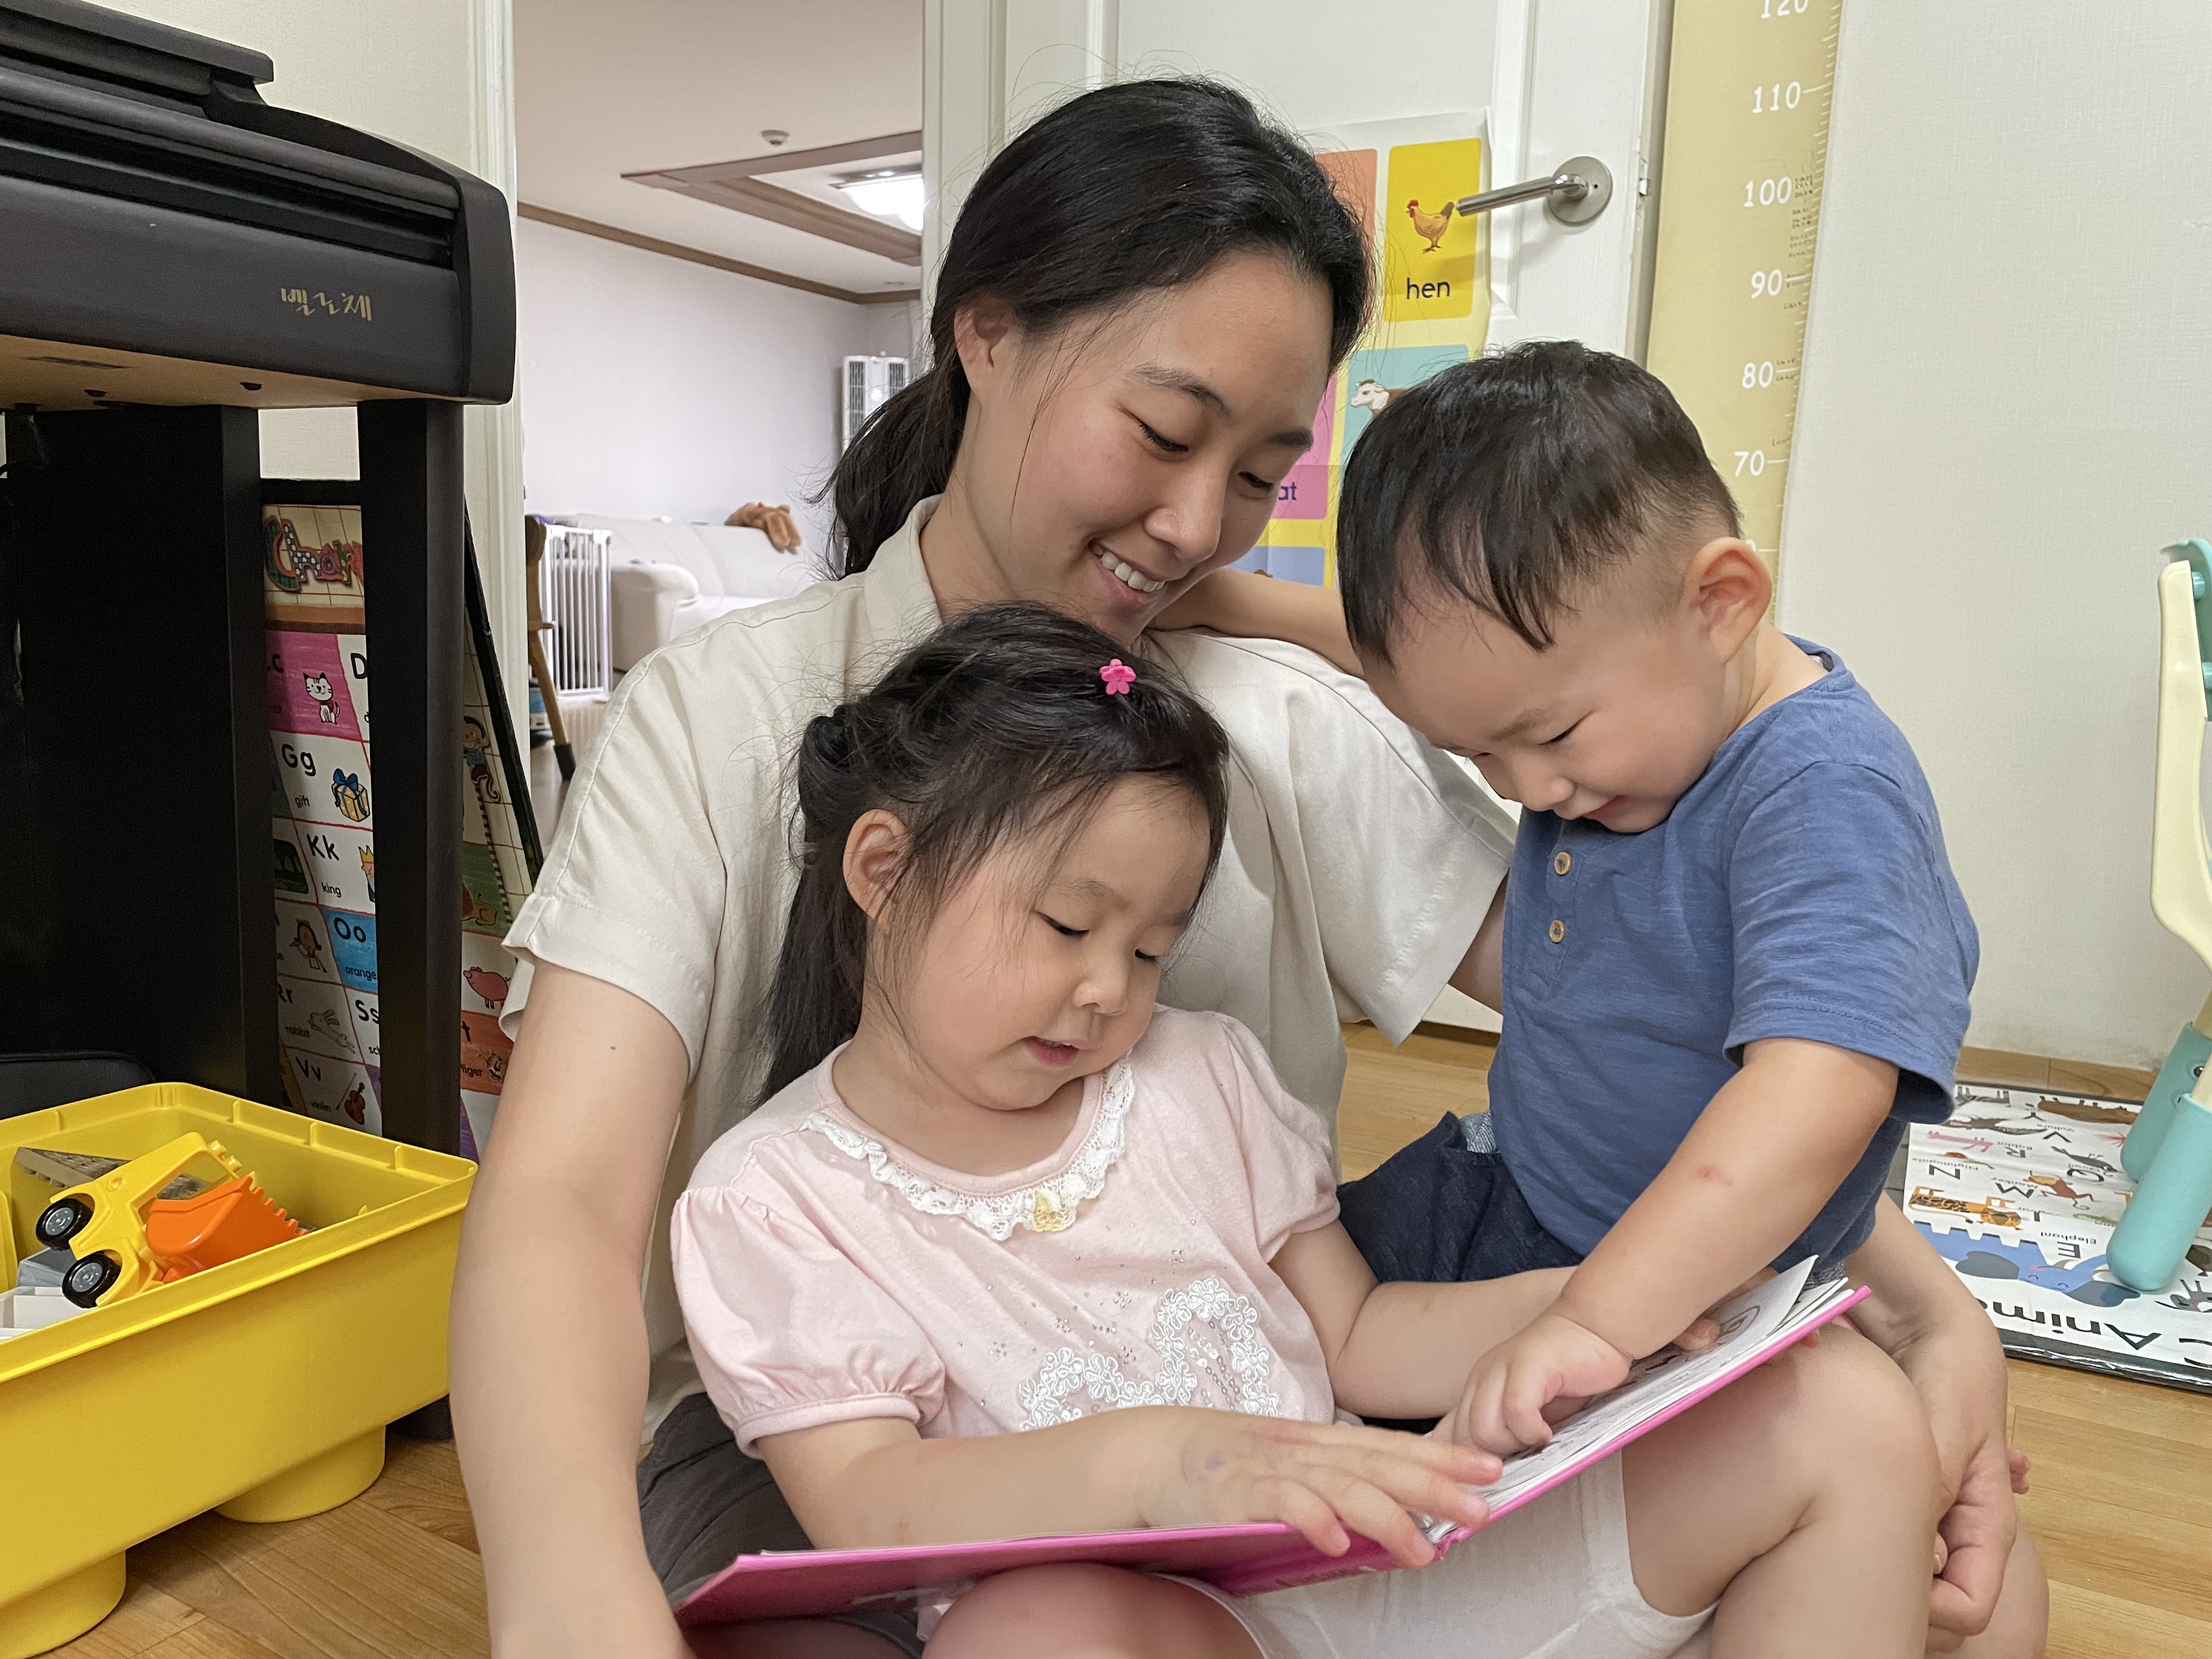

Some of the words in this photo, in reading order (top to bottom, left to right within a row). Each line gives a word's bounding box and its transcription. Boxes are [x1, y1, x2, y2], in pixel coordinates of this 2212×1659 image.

[1752, 81, 1801, 113] 110
[1744, 177, 1792, 207] 100
[1406, 278, 1451, 300] hen
[1751, 269, 1782, 298] 90
[1742, 361, 1774, 388] 80
[1734, 450, 1765, 477] 70
[1278, 482, 1297, 500] at
[281, 743, 316, 777] Gg
[295, 795, 310, 808] gift
[306, 833, 339, 861] Kk
[321, 882, 341, 898] king
[334, 917, 366, 944] Oo
[345, 966, 376, 980] orange
[355, 1000, 379, 1025] Ss
[369, 1046, 380, 1055] sc
[295, 1056, 321, 1081] Vv
[1929, 1164, 1961, 1180] N
[2041, 1232, 2096, 1244] Elephant
[2057, 1241, 2081, 1259] E
